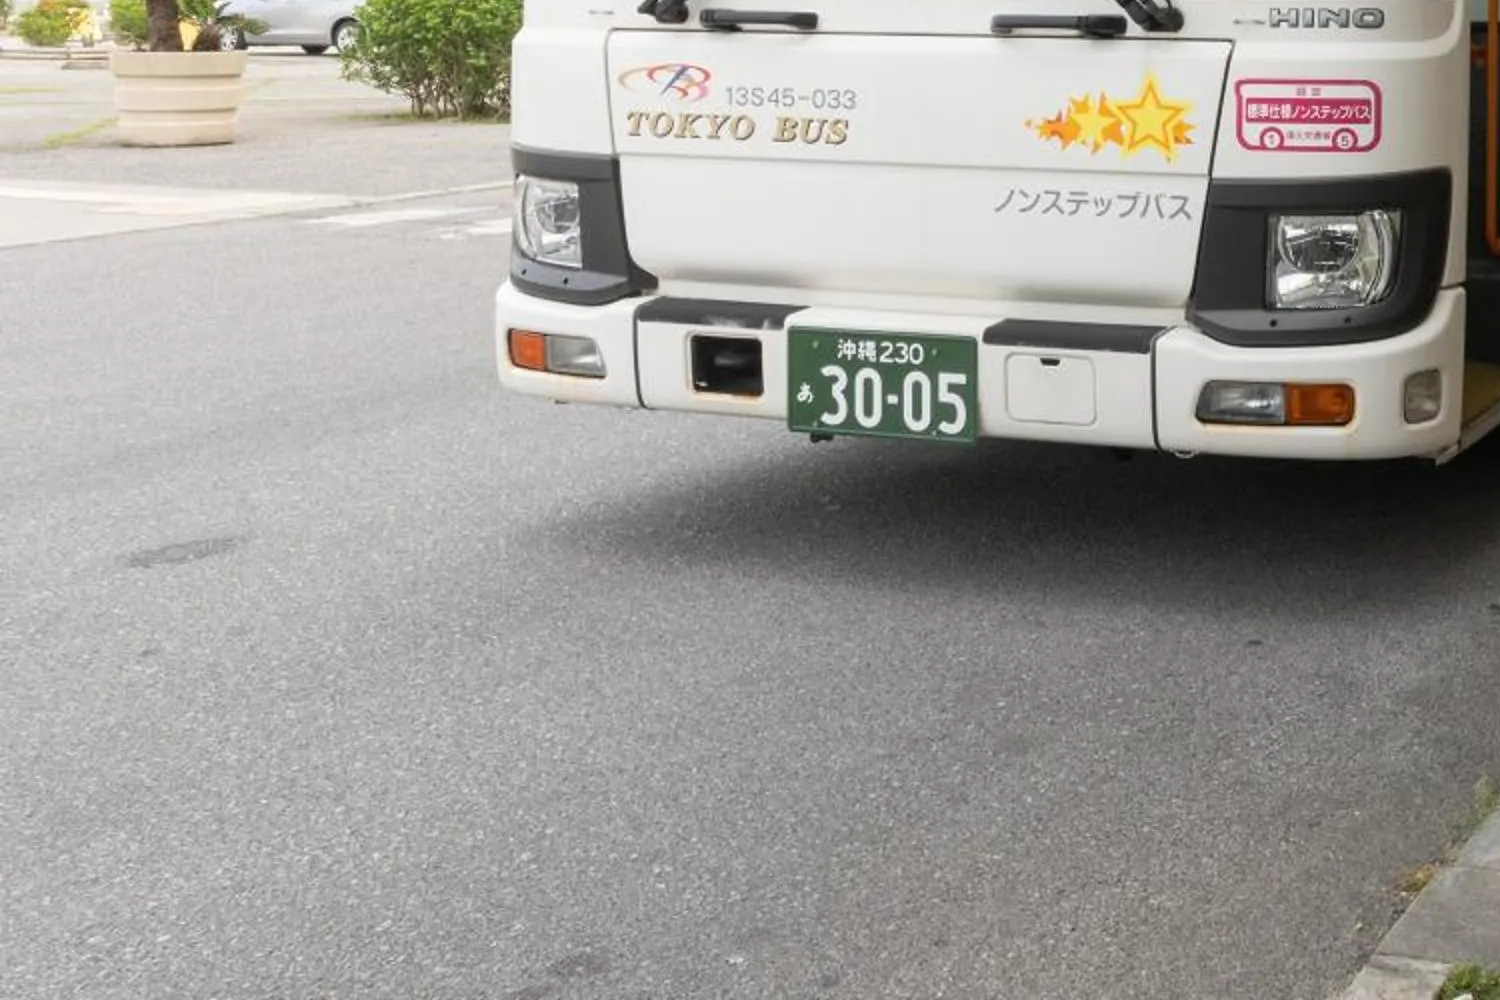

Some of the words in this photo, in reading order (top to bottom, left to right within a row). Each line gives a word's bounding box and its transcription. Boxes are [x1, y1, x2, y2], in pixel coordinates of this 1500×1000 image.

[1269, 7, 1385, 29] HINO
[726, 87, 858, 110] 13S45-033
[627, 111, 756, 142] TOKYO
[773, 116, 849, 145] BUS
[995, 189, 1192, 221] ノンステップバス
[796, 382, 815, 404] あ
[820, 364, 967, 435] 30-05
